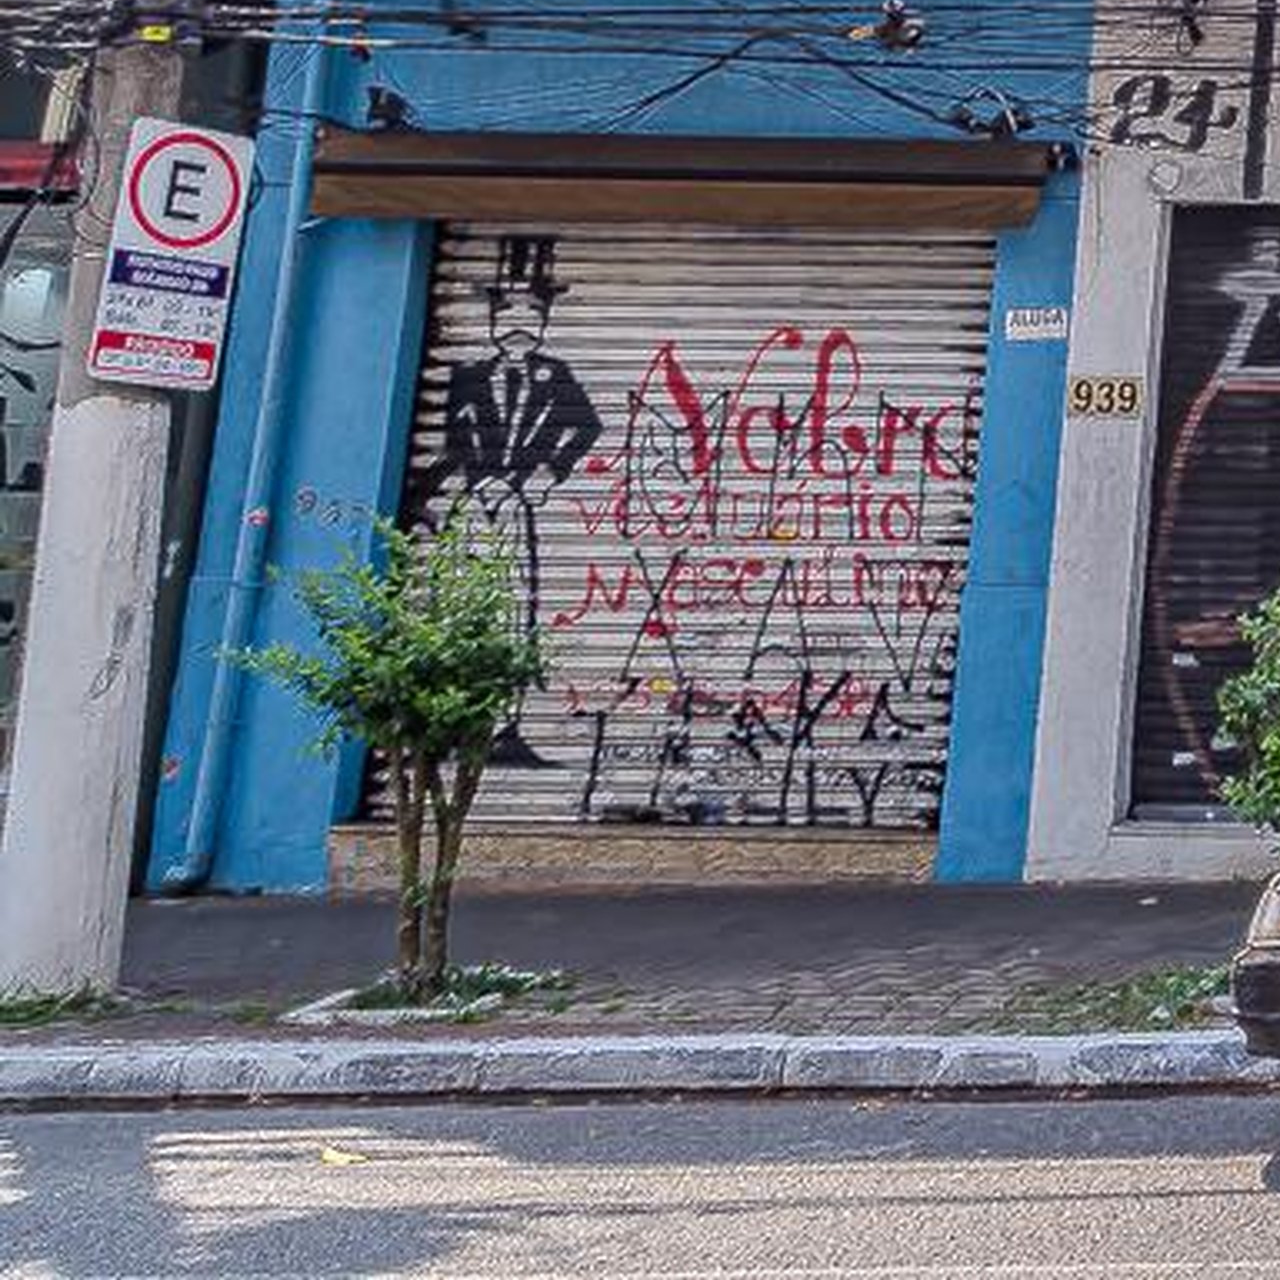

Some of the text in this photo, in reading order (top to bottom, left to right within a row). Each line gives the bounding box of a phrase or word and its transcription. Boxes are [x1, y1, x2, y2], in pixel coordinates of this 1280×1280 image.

[163, 160, 208, 221] E
[1009, 309, 1064, 327] ALUGA
[1074, 380, 1137, 414] 939
